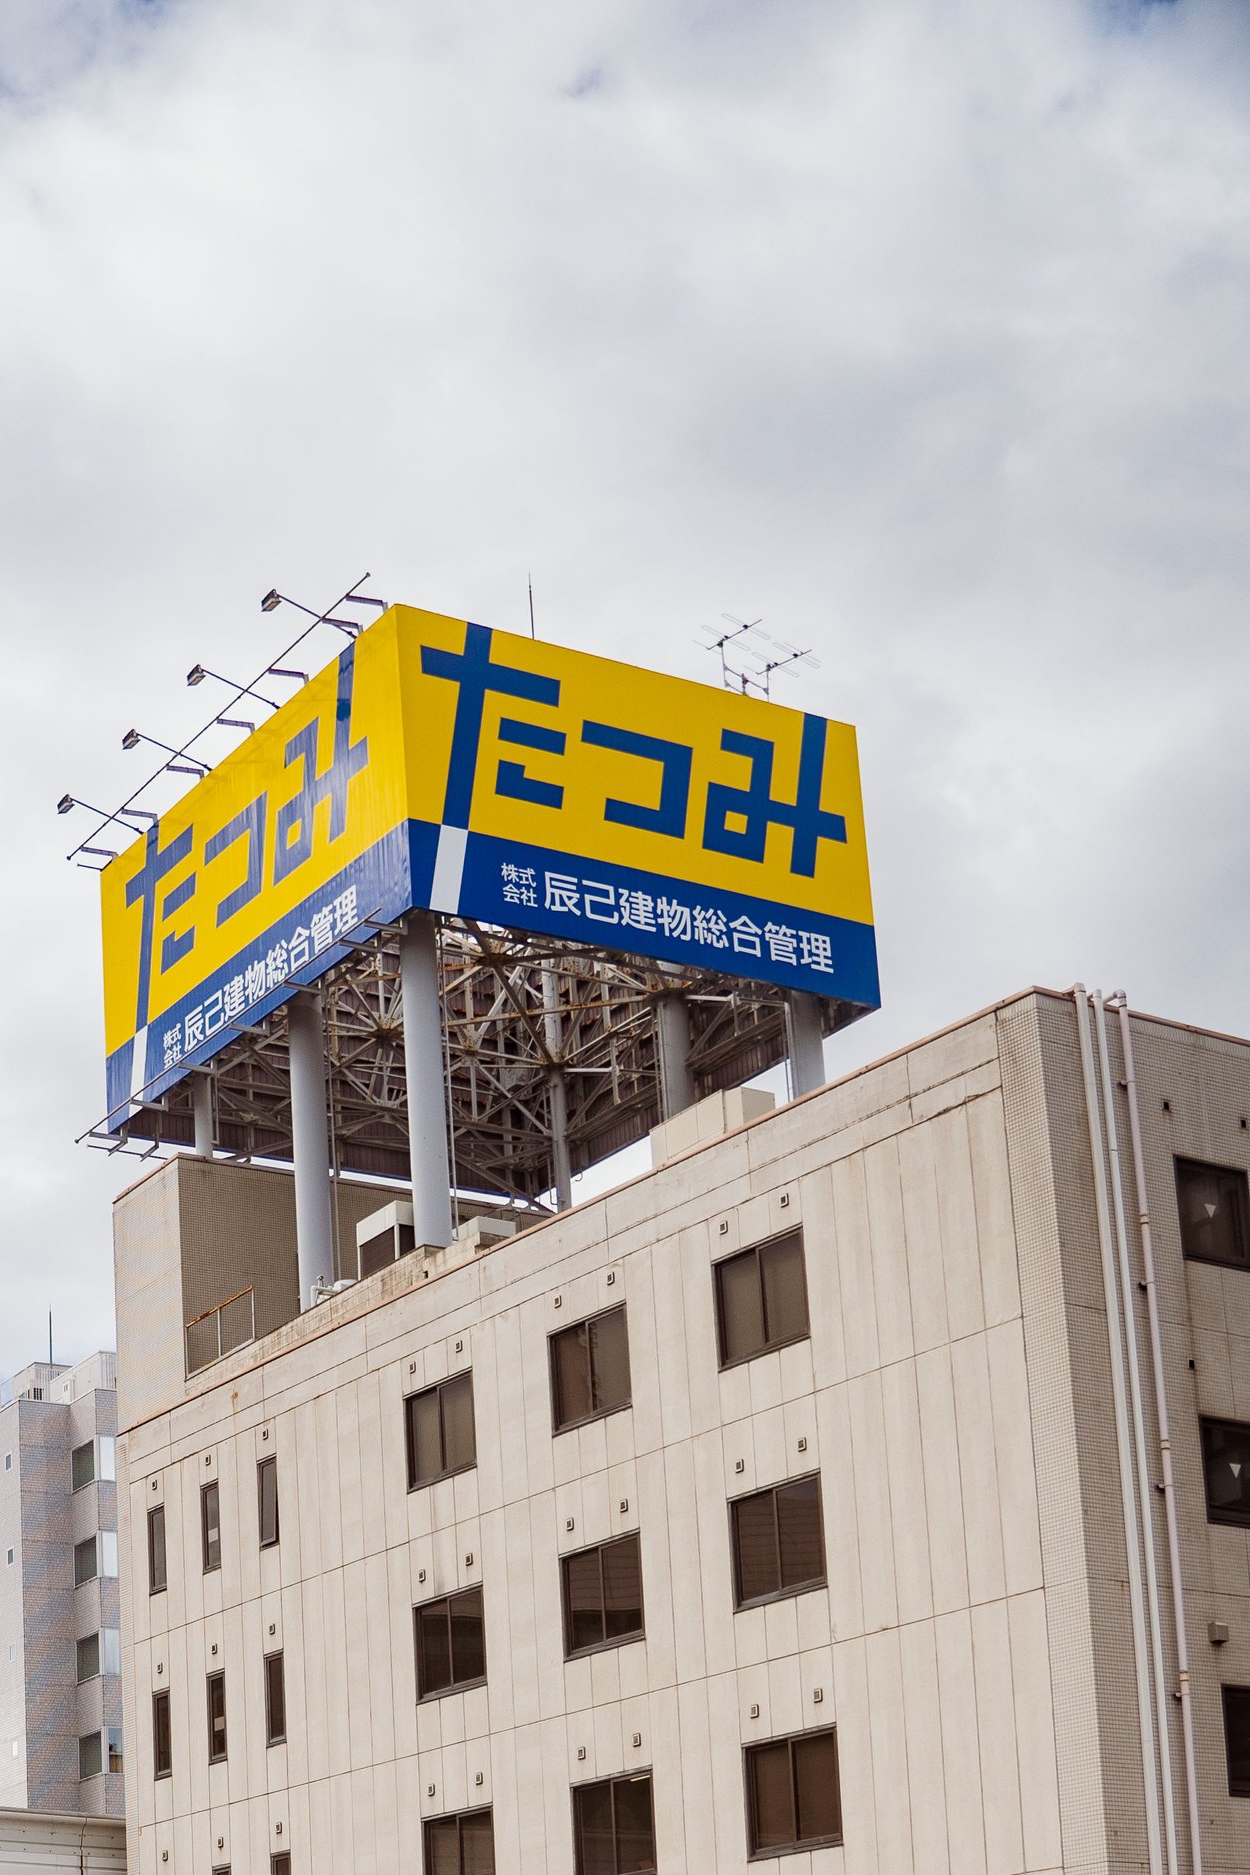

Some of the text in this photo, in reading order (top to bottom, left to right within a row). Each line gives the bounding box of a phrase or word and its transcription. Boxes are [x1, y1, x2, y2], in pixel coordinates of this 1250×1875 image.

[124, 640, 370, 1032] たつみ
[420, 622, 848, 879] たつみ
